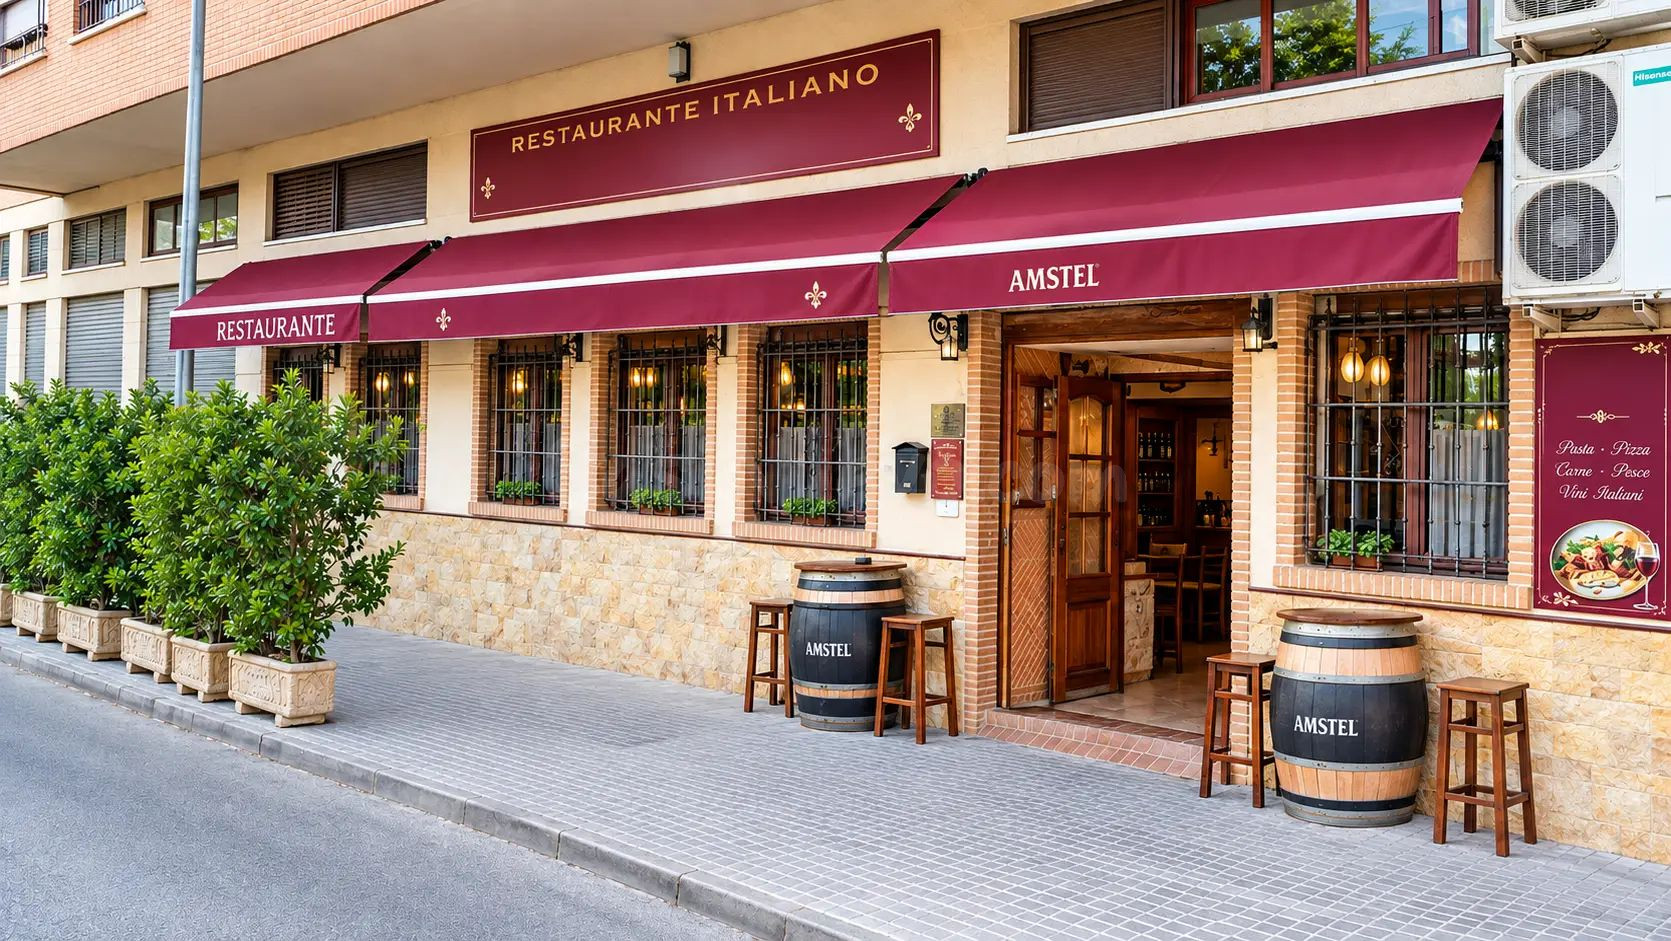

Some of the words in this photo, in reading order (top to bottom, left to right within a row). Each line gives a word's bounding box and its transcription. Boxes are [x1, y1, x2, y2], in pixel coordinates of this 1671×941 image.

[511, 100, 699, 153] RESTAURANTE
[713, 63, 879, 115] ITALIANO
[1008, 263, 1100, 292] AMSTEL
[217, 313, 335, 342] RESTAURANTE
[1556, 440, 1594, 455] Pasta
[1611, 440, 1651, 456] Pizza
[1555, 461, 1593, 477] Carne
[1611, 462, 1650, 478] Pesce
[1560, 484, 1588, 499] Vini
[1593, 485, 1645, 501] Italiani
[805, 641, 852, 657] AMSTEL
[1293, 714, 1359, 737] AMSTEL
